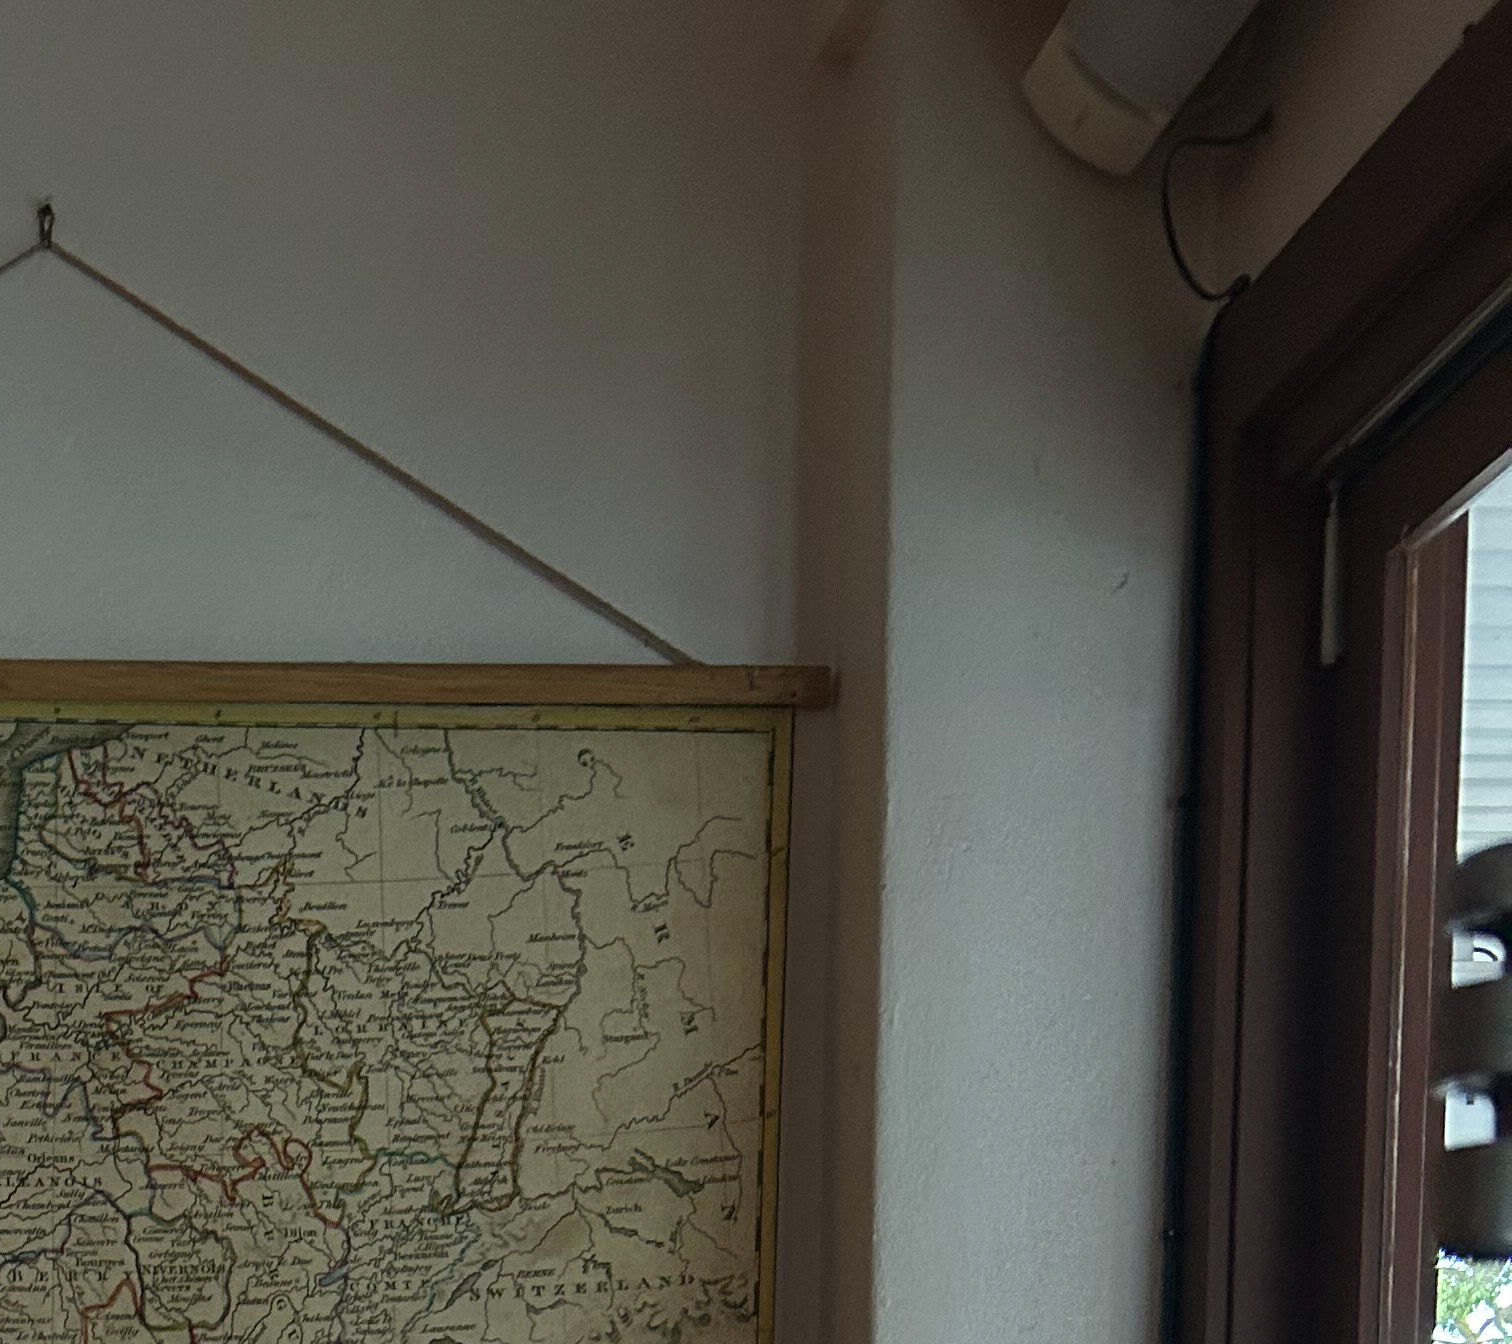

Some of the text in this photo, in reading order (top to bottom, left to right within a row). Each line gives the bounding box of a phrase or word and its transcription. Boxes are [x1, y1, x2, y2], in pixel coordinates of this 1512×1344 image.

[26, 1152, 75, 1164] Orleans
[283, 1226, 319, 1240] Dijon
[516, 1267, 557, 1280] BERNE
